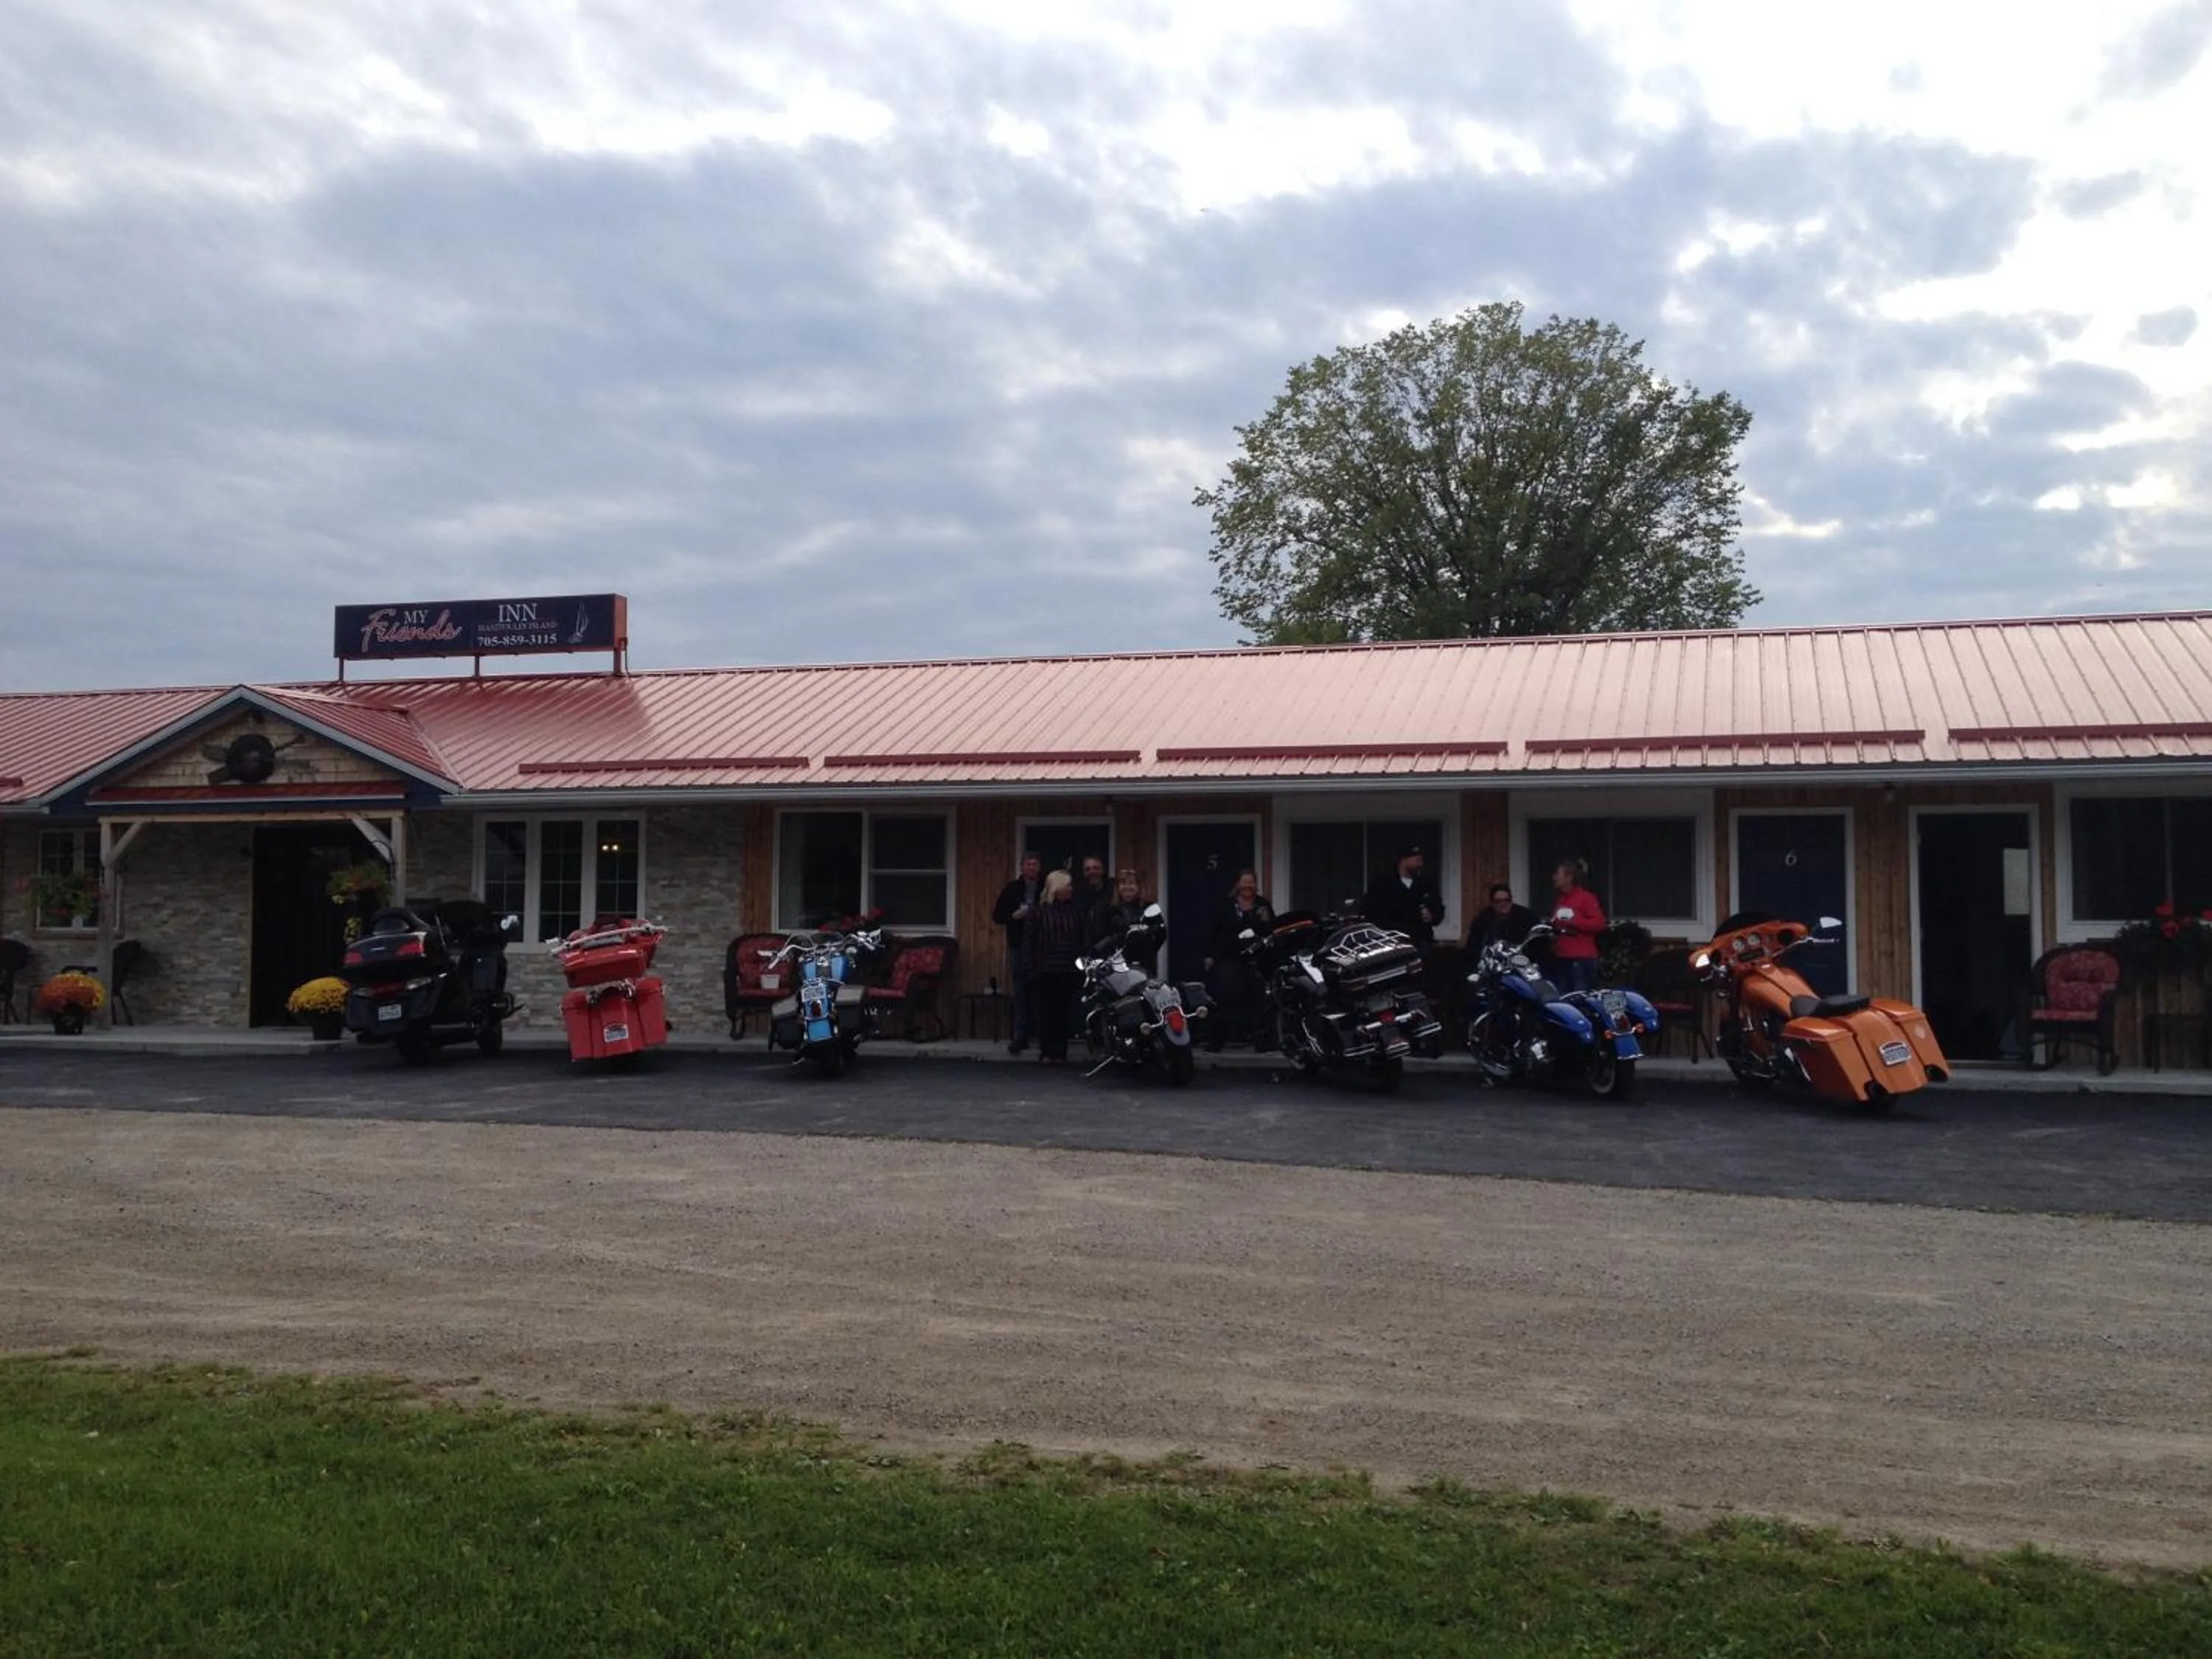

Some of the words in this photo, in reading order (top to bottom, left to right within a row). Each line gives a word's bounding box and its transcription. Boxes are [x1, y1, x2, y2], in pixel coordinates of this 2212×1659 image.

[403, 610, 429, 624] MY
[498, 602, 538, 622] INN
[477, 633, 557, 647] 705-859-3115
[1206, 853, 1219, 869] 5
[1784, 848, 1798, 866] 6
